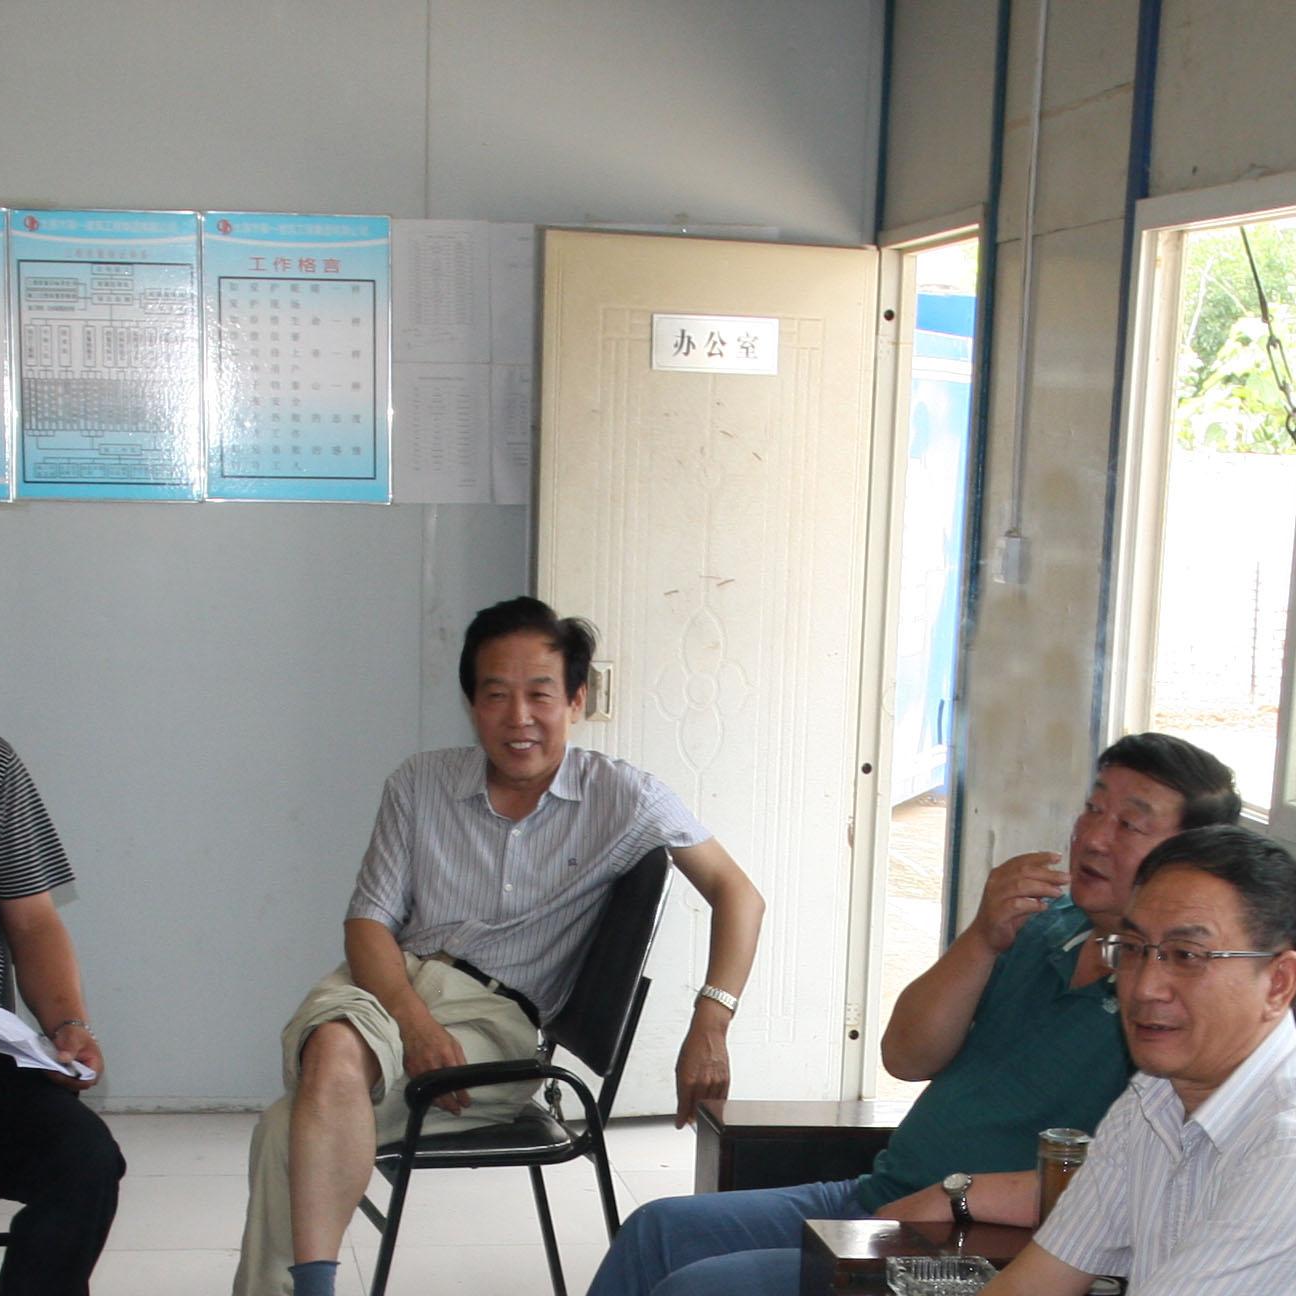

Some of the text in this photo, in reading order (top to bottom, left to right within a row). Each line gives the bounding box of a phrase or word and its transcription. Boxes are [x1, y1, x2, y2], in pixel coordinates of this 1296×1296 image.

[248, 256, 342, 274] 工作格言
[672, 328, 759, 360] 办公室
